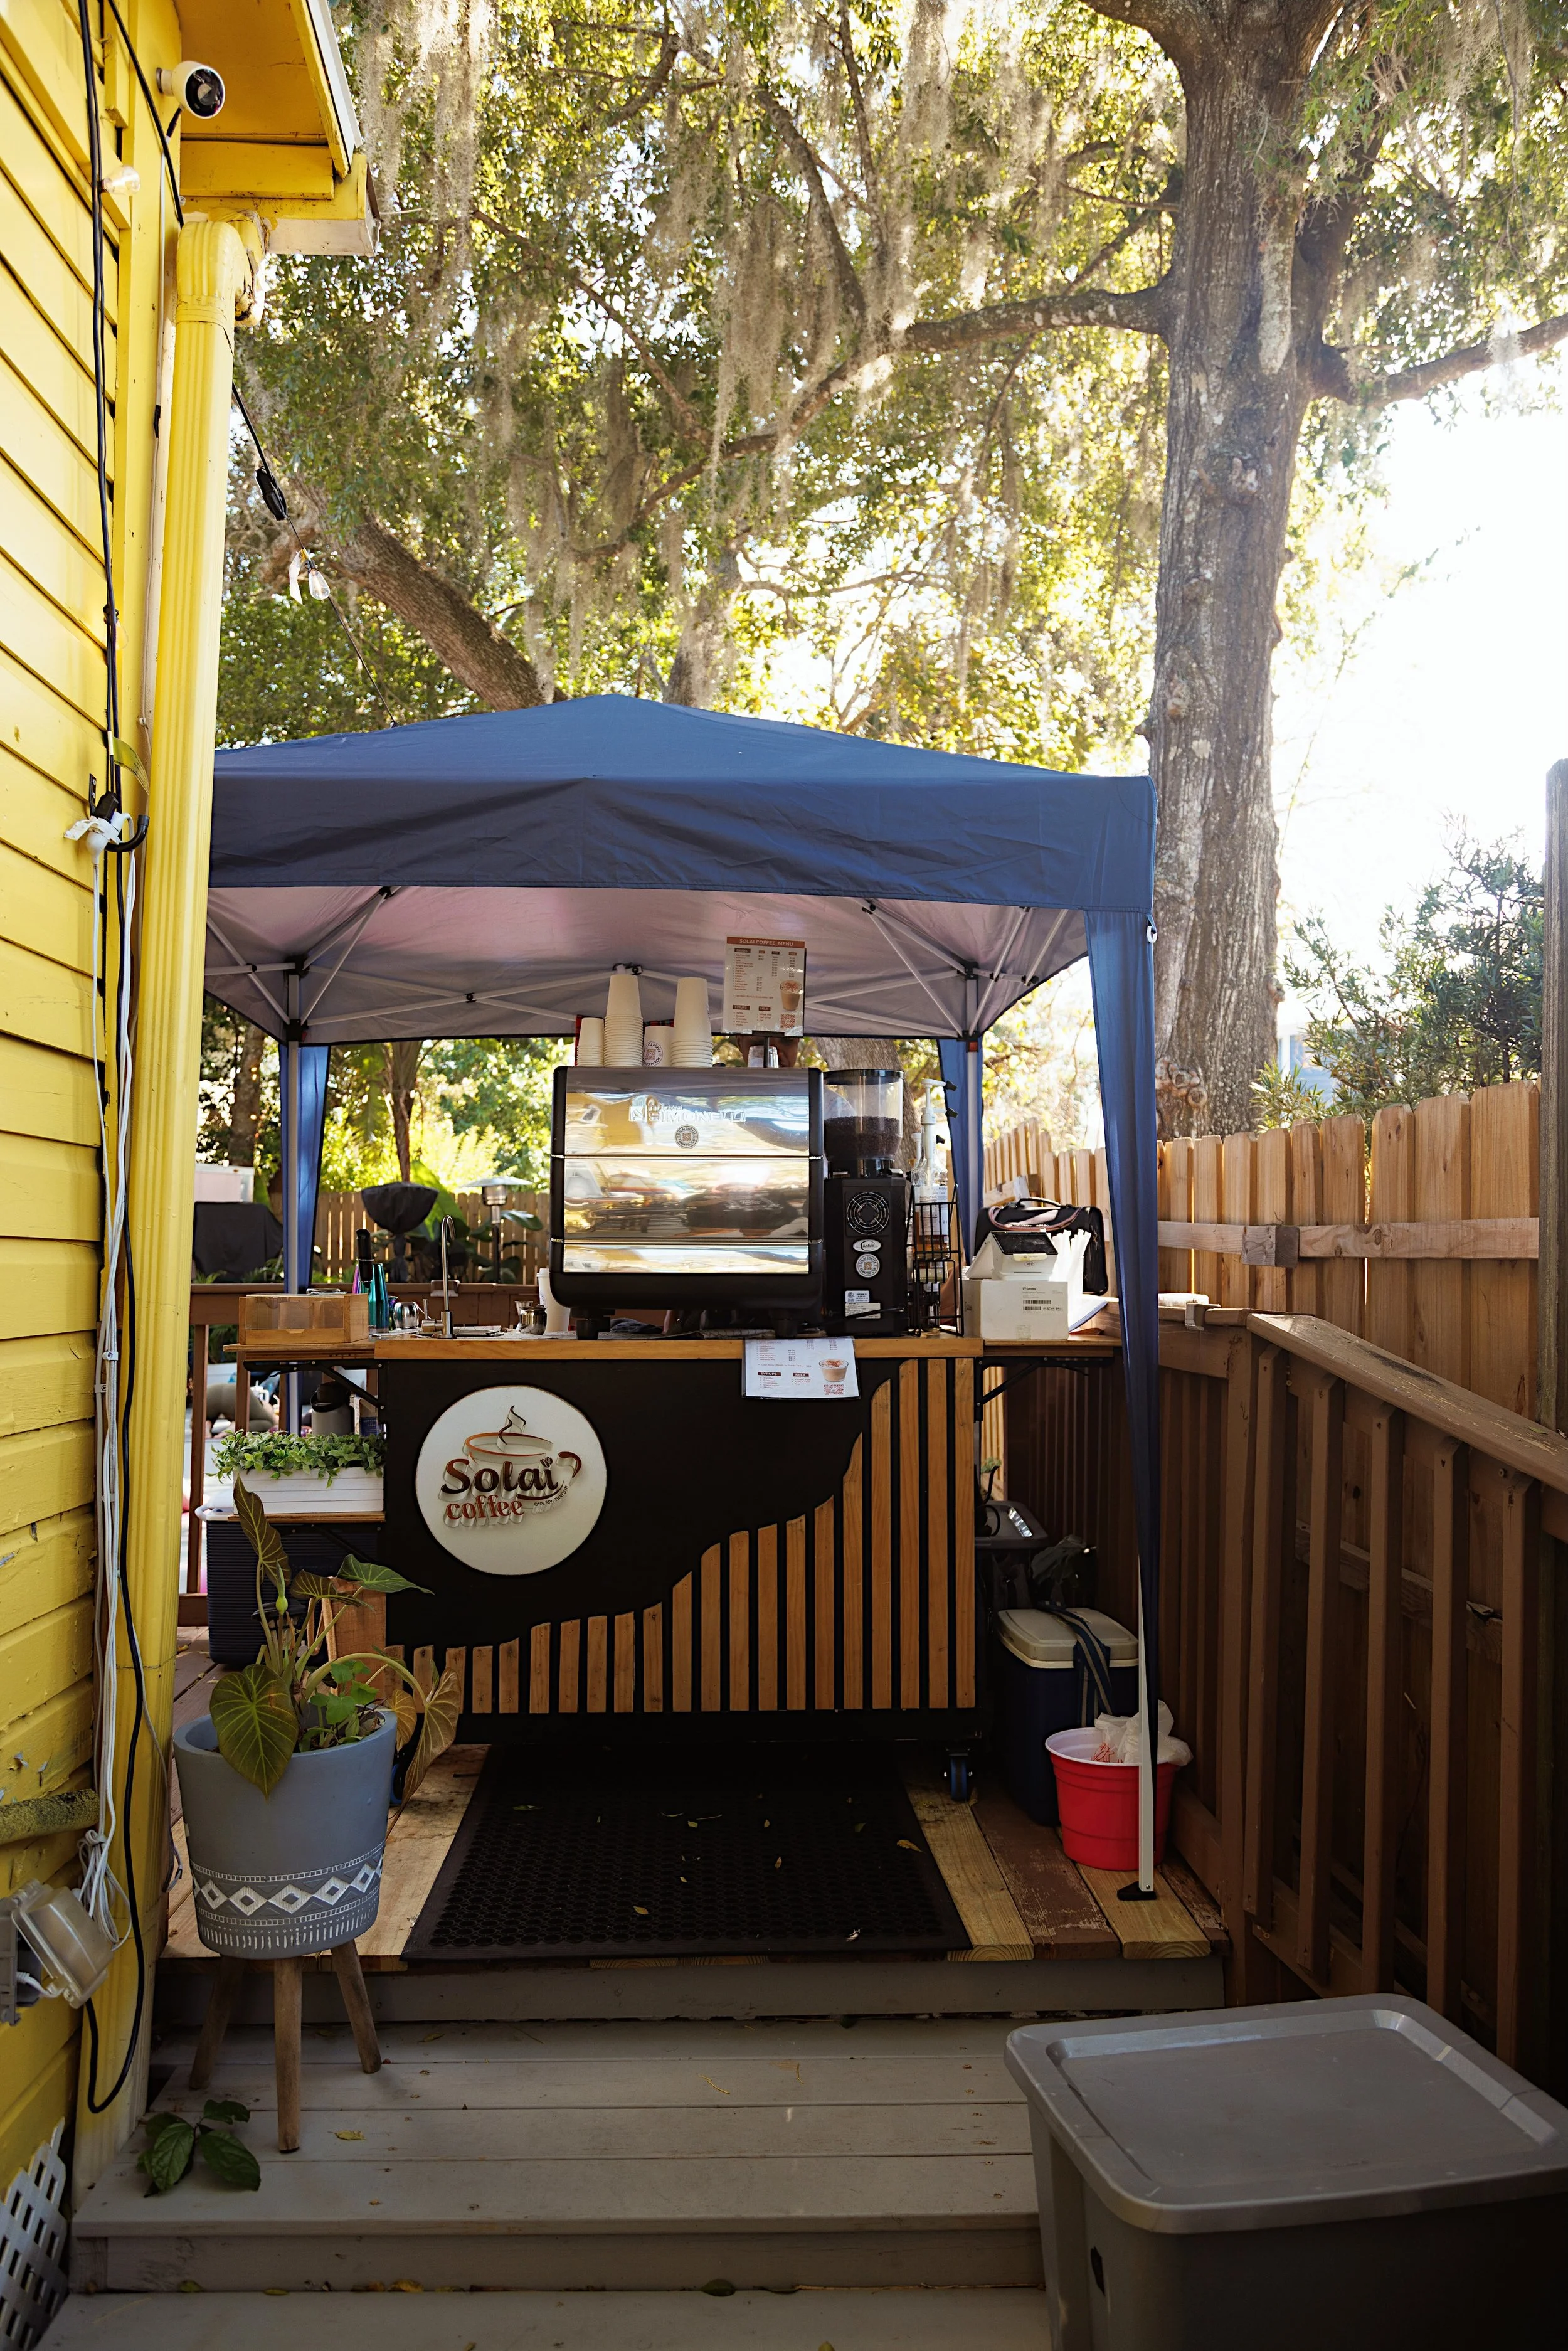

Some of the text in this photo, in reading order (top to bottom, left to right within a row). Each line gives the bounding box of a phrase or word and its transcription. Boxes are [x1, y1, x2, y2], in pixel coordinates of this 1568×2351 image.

[651, 1057, 661, 1066] SOLAI
[649, 1109, 746, 1122] SIMONELLI
[446, 1495, 525, 1520] coffee
